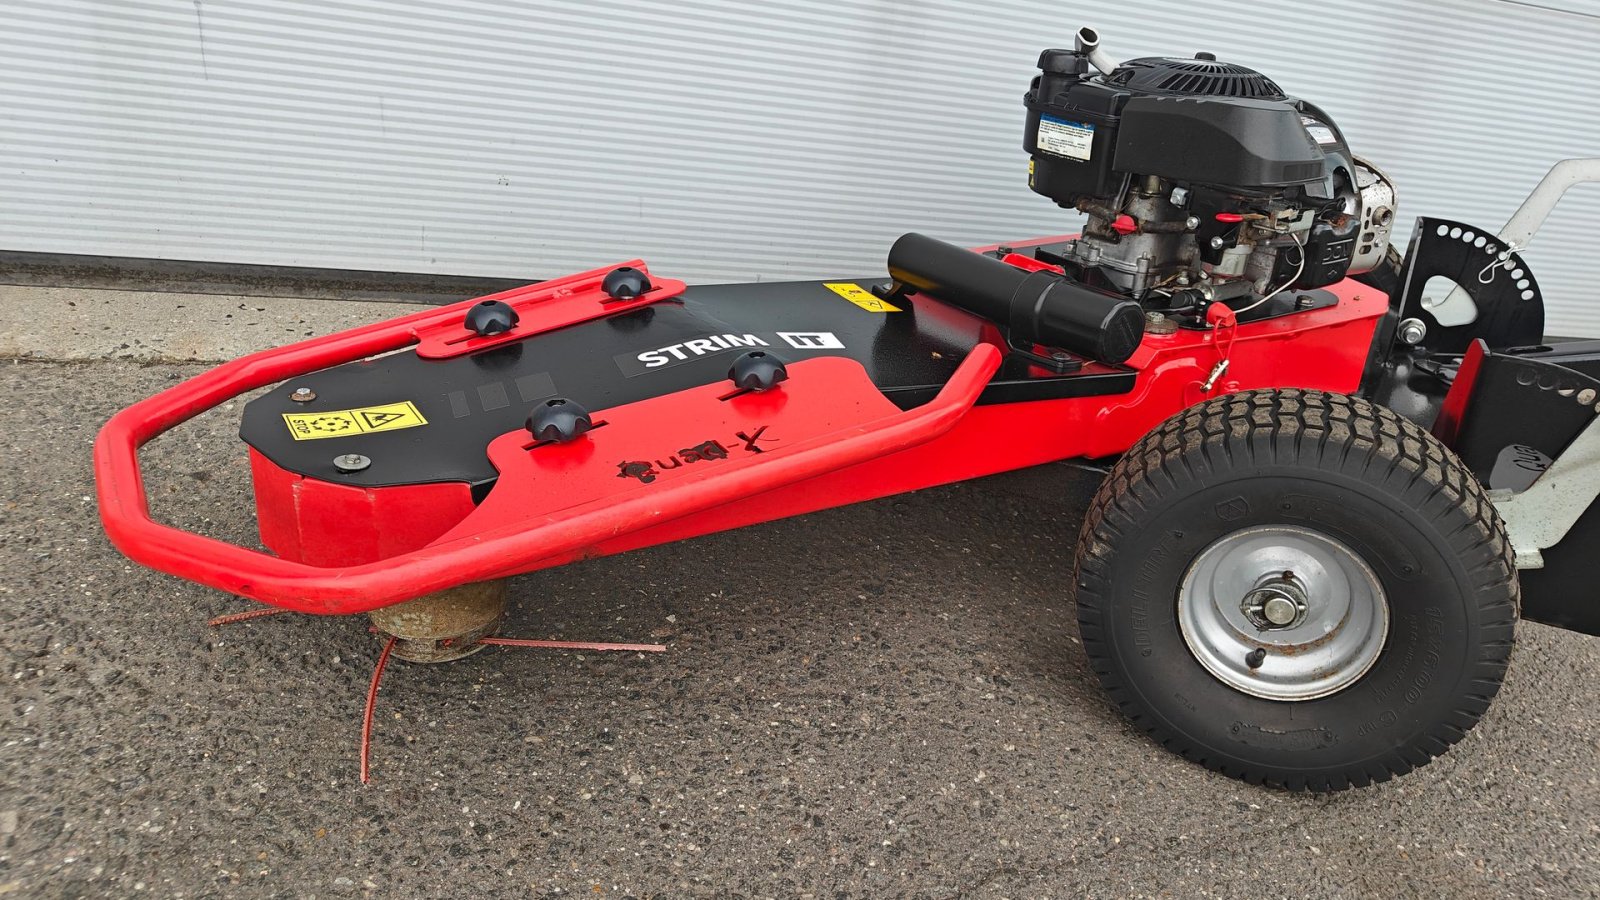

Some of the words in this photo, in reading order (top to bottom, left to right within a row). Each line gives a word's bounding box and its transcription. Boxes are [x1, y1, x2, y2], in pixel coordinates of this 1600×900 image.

[637, 333, 770, 368] STRIM
[788, 335, 825, 346] IT
[293, 419, 311, 434] STOP
